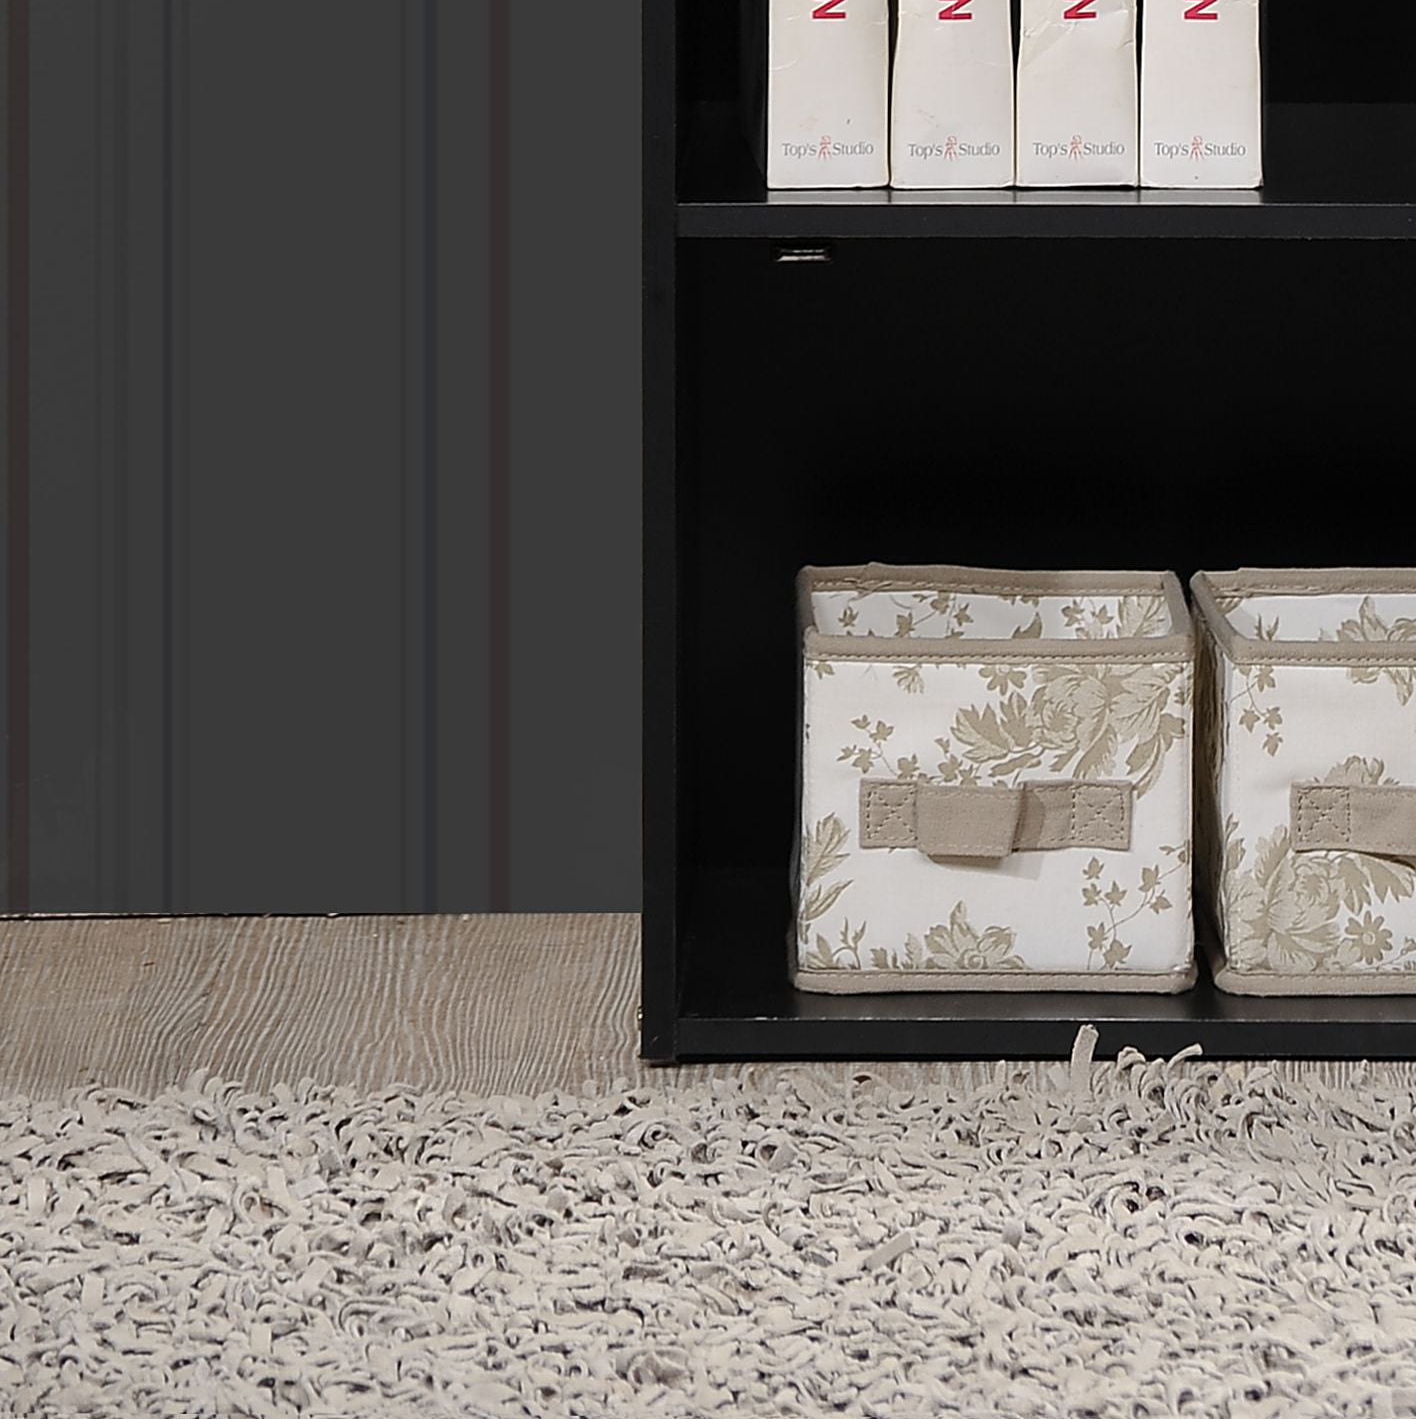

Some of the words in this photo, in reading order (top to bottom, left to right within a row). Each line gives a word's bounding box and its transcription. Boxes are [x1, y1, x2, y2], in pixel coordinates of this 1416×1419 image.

[782, 141, 817, 159] Top's
[832, 140, 874, 156] Studio
[908, 142, 943, 159] Top's
[958, 141, 1001, 157] Studio
[1033, 141, 1068, 159] Top's
[1083, 140, 1125, 156] Studio
[1154, 141, 1189, 159] Top's
[1205, 141, 1246, 157] Studio
